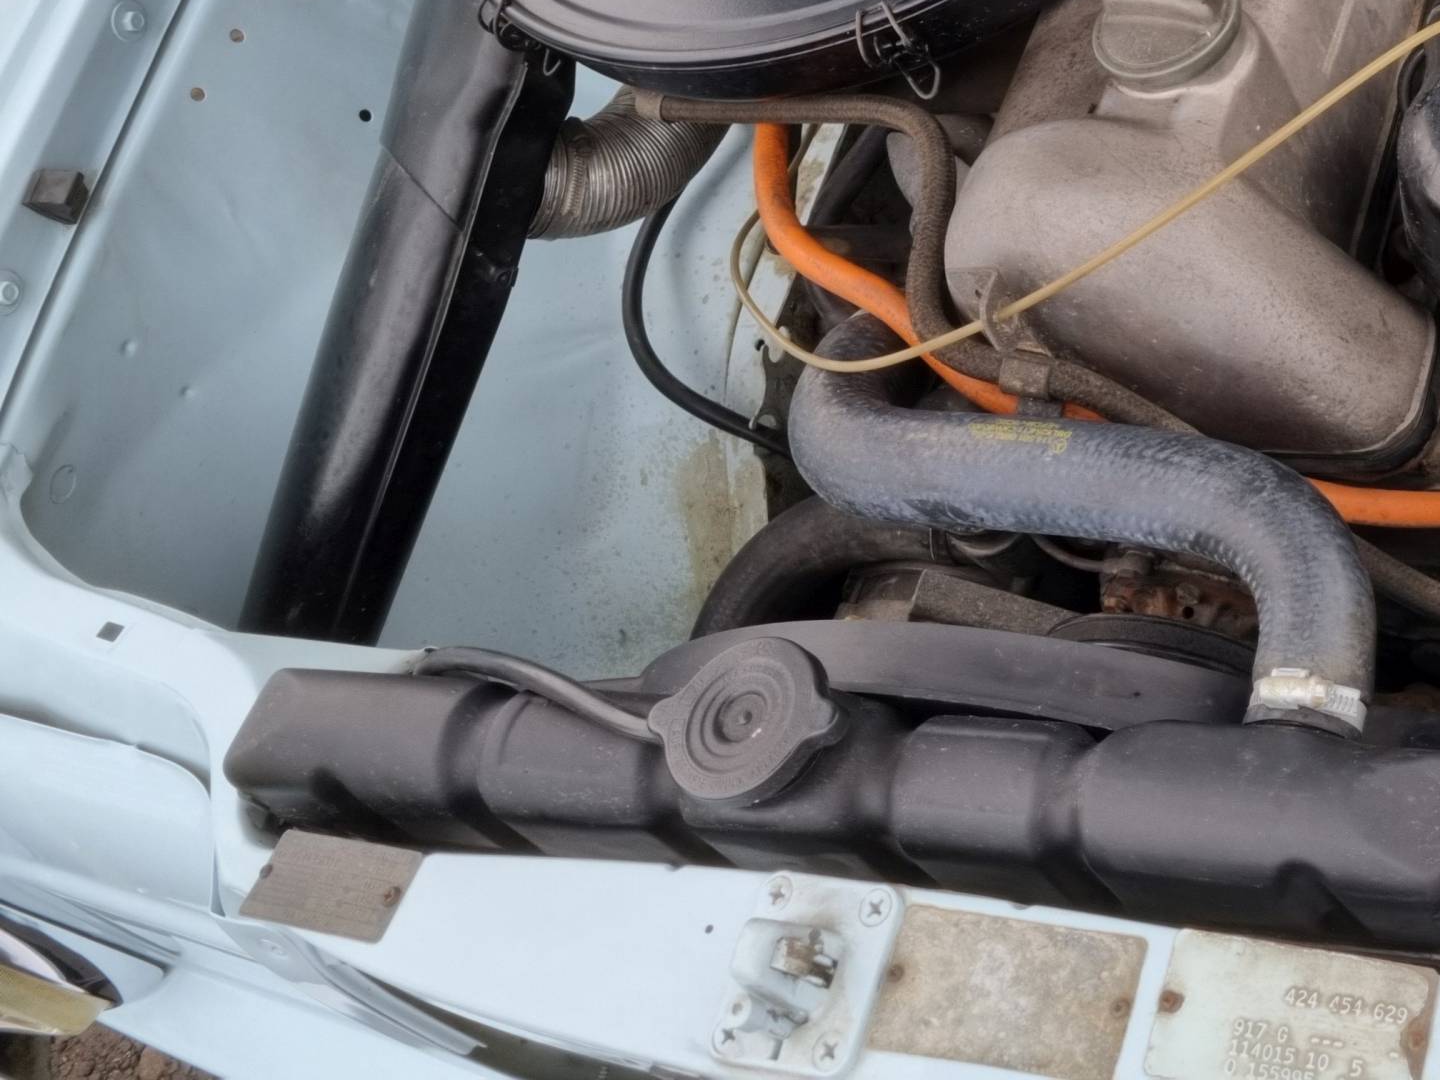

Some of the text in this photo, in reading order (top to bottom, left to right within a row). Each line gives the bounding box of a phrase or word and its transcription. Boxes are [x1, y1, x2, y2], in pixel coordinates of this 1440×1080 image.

[1284, 987, 1408, 1024] 424 454 629
[1232, 1018, 1267, 1040] 917
[1229, 1039, 1363, 1077] 114015 10 5
